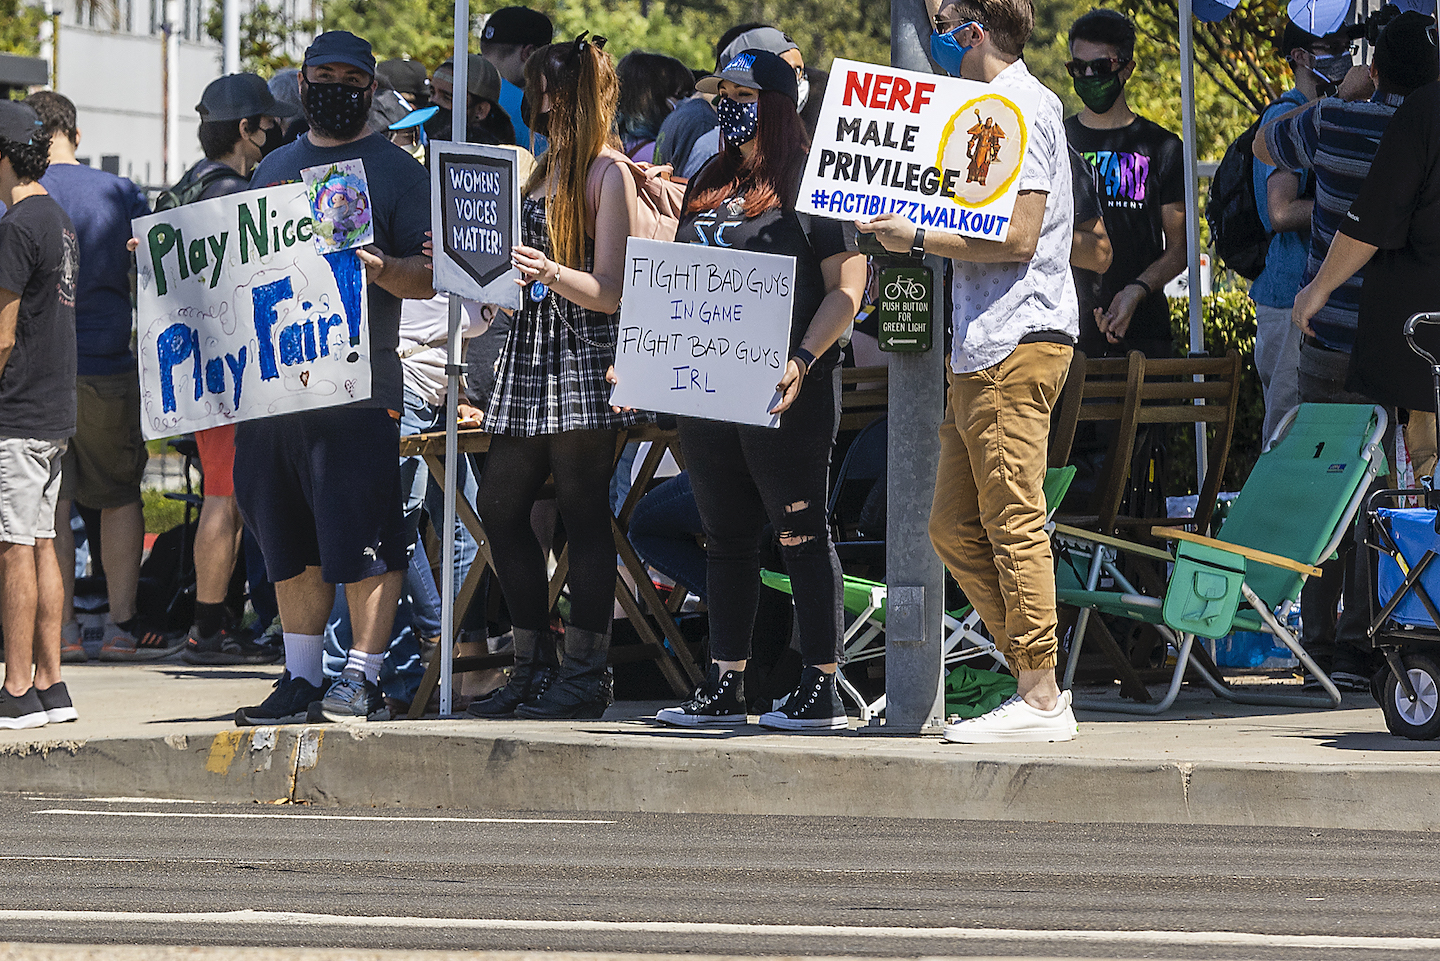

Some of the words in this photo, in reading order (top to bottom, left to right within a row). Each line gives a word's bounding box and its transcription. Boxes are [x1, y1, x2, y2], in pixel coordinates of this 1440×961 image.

[842, 70, 936, 114] NERF
[835, 116, 920, 152] MALE
[449, 166, 501, 196] WOMENS
[817, 148, 961, 199] PRIVILEGE
[454, 197, 498, 226] VOICES
[811, 189, 1009, 236] #ACTIBLIZZWALKOUT
[147, 223, 229, 297] Play
[237, 196, 313, 265] Nice
[453, 225, 503, 256] MATTER!
[631, 257, 701, 294] FIGHT
[705, 263, 744, 293] BAD
[746, 267, 790, 299] GUYS
[670, 299, 694, 320] IN
[698, 301, 743, 325] GAME
[881, 301, 900, 311] PUSH
[902, 301, 929, 312] BUTTON
[897, 312, 912, 322] FOR
[882, 322, 906, 332] GREEN
[907, 322, 927, 333] LIGHT
[622, 326, 683, 357] FIGHT
[687, 335, 730, 358] BAD
[735, 340, 780, 369] GUYS
[156, 322, 248, 415] Play
[670, 365, 716, 393] IRL
